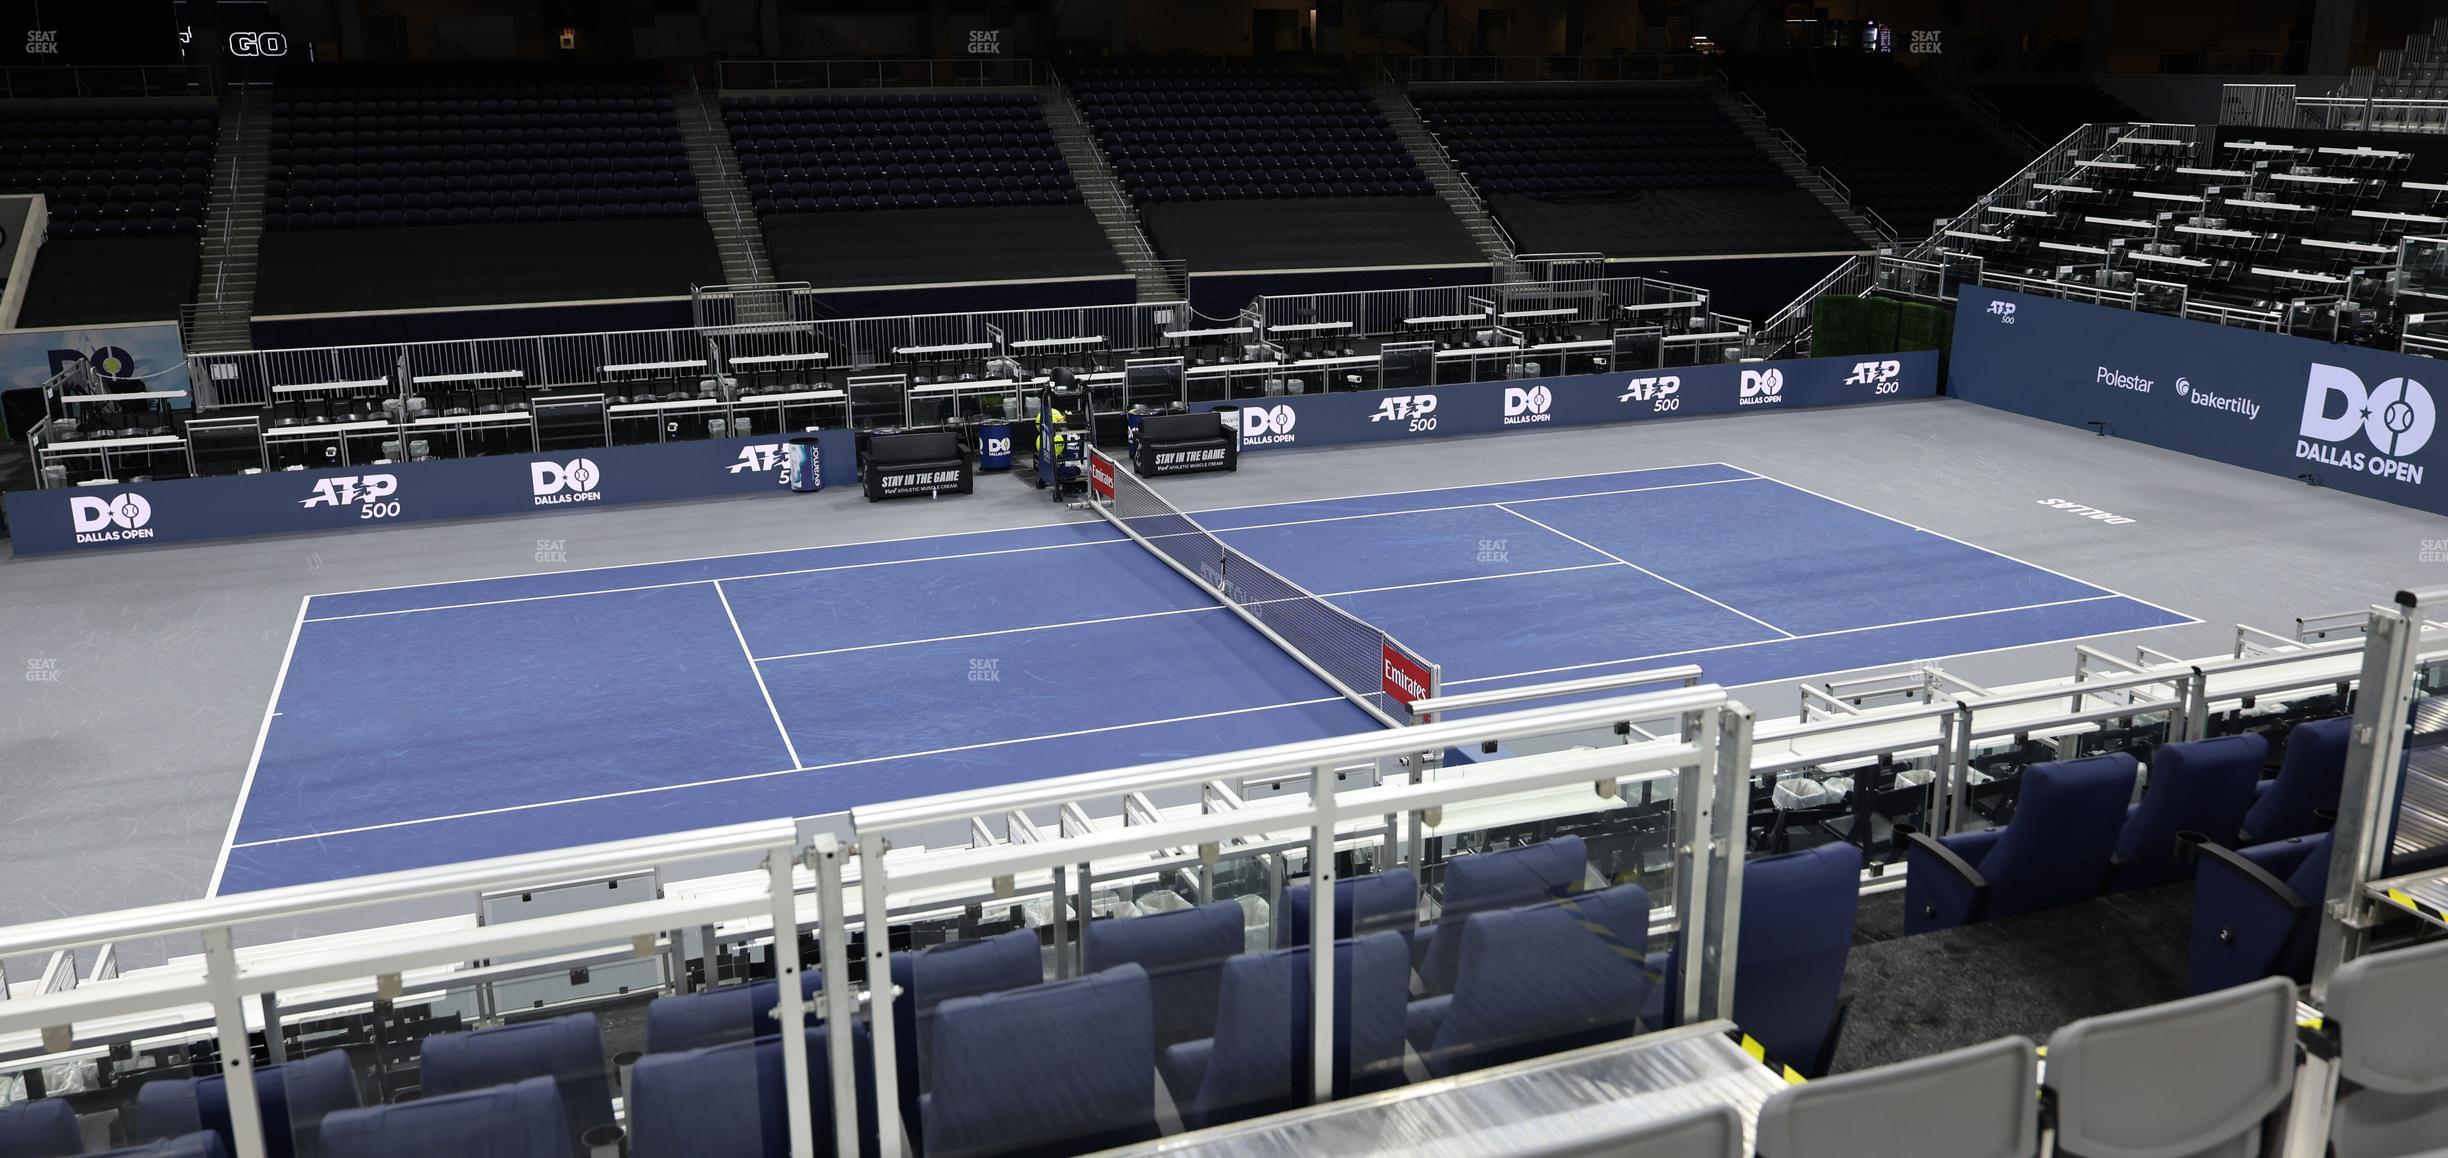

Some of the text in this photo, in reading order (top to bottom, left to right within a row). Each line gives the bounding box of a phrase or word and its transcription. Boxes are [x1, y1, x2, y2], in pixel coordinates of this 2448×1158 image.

[229, 31, 288, 56] GO
[1986, 300, 2016, 315] ATP
[2001, 315, 2015, 325] 500
[1739, 367, 1784, 398] DO
[1843, 360, 1901, 385] ATP
[2096, 366, 2154, 393] Polestar
[1504, 385, 1552, 417] DO
[1617, 376, 1681, 402] ATP
[1739, 395, 1782, 406] DALLAS OPEN
[1875, 382, 1899, 395] 500
[1368, 394, 1438, 423] ATP
[1653, 398, 1680, 412] 500
[2191, 389, 2260, 421] bakertilly
[2299, 362, 2436, 457] DO
[1242, 404, 1296, 436] DO
[1408, 418, 1437, 432] 500
[1504, 413, 1551, 425] DALLAS OPEN
[1243, 433, 1295, 446] DALLAS OPEN
[812, 446, 821, 487] evamor
[1155, 448, 1226, 465] STAY IN THE GAME
[2295, 440, 2424, 485] DALLAS OPEN
[530, 458, 600, 496] DO
[881, 470, 960, 488] STAY IN THE GAME
[1092, 464, 1114, 489] Emirates
[298, 473, 398, 508] ATP
[534, 491, 601, 505] DALLAS OPEN
[70, 492, 151, 533] DO
[360, 501, 401, 519] 500
[2036, 498, 2137, 525] DALLAS
[76, 528, 154, 544] DALLAS OPEN
[1385, 658, 1427, 701] Emirates
